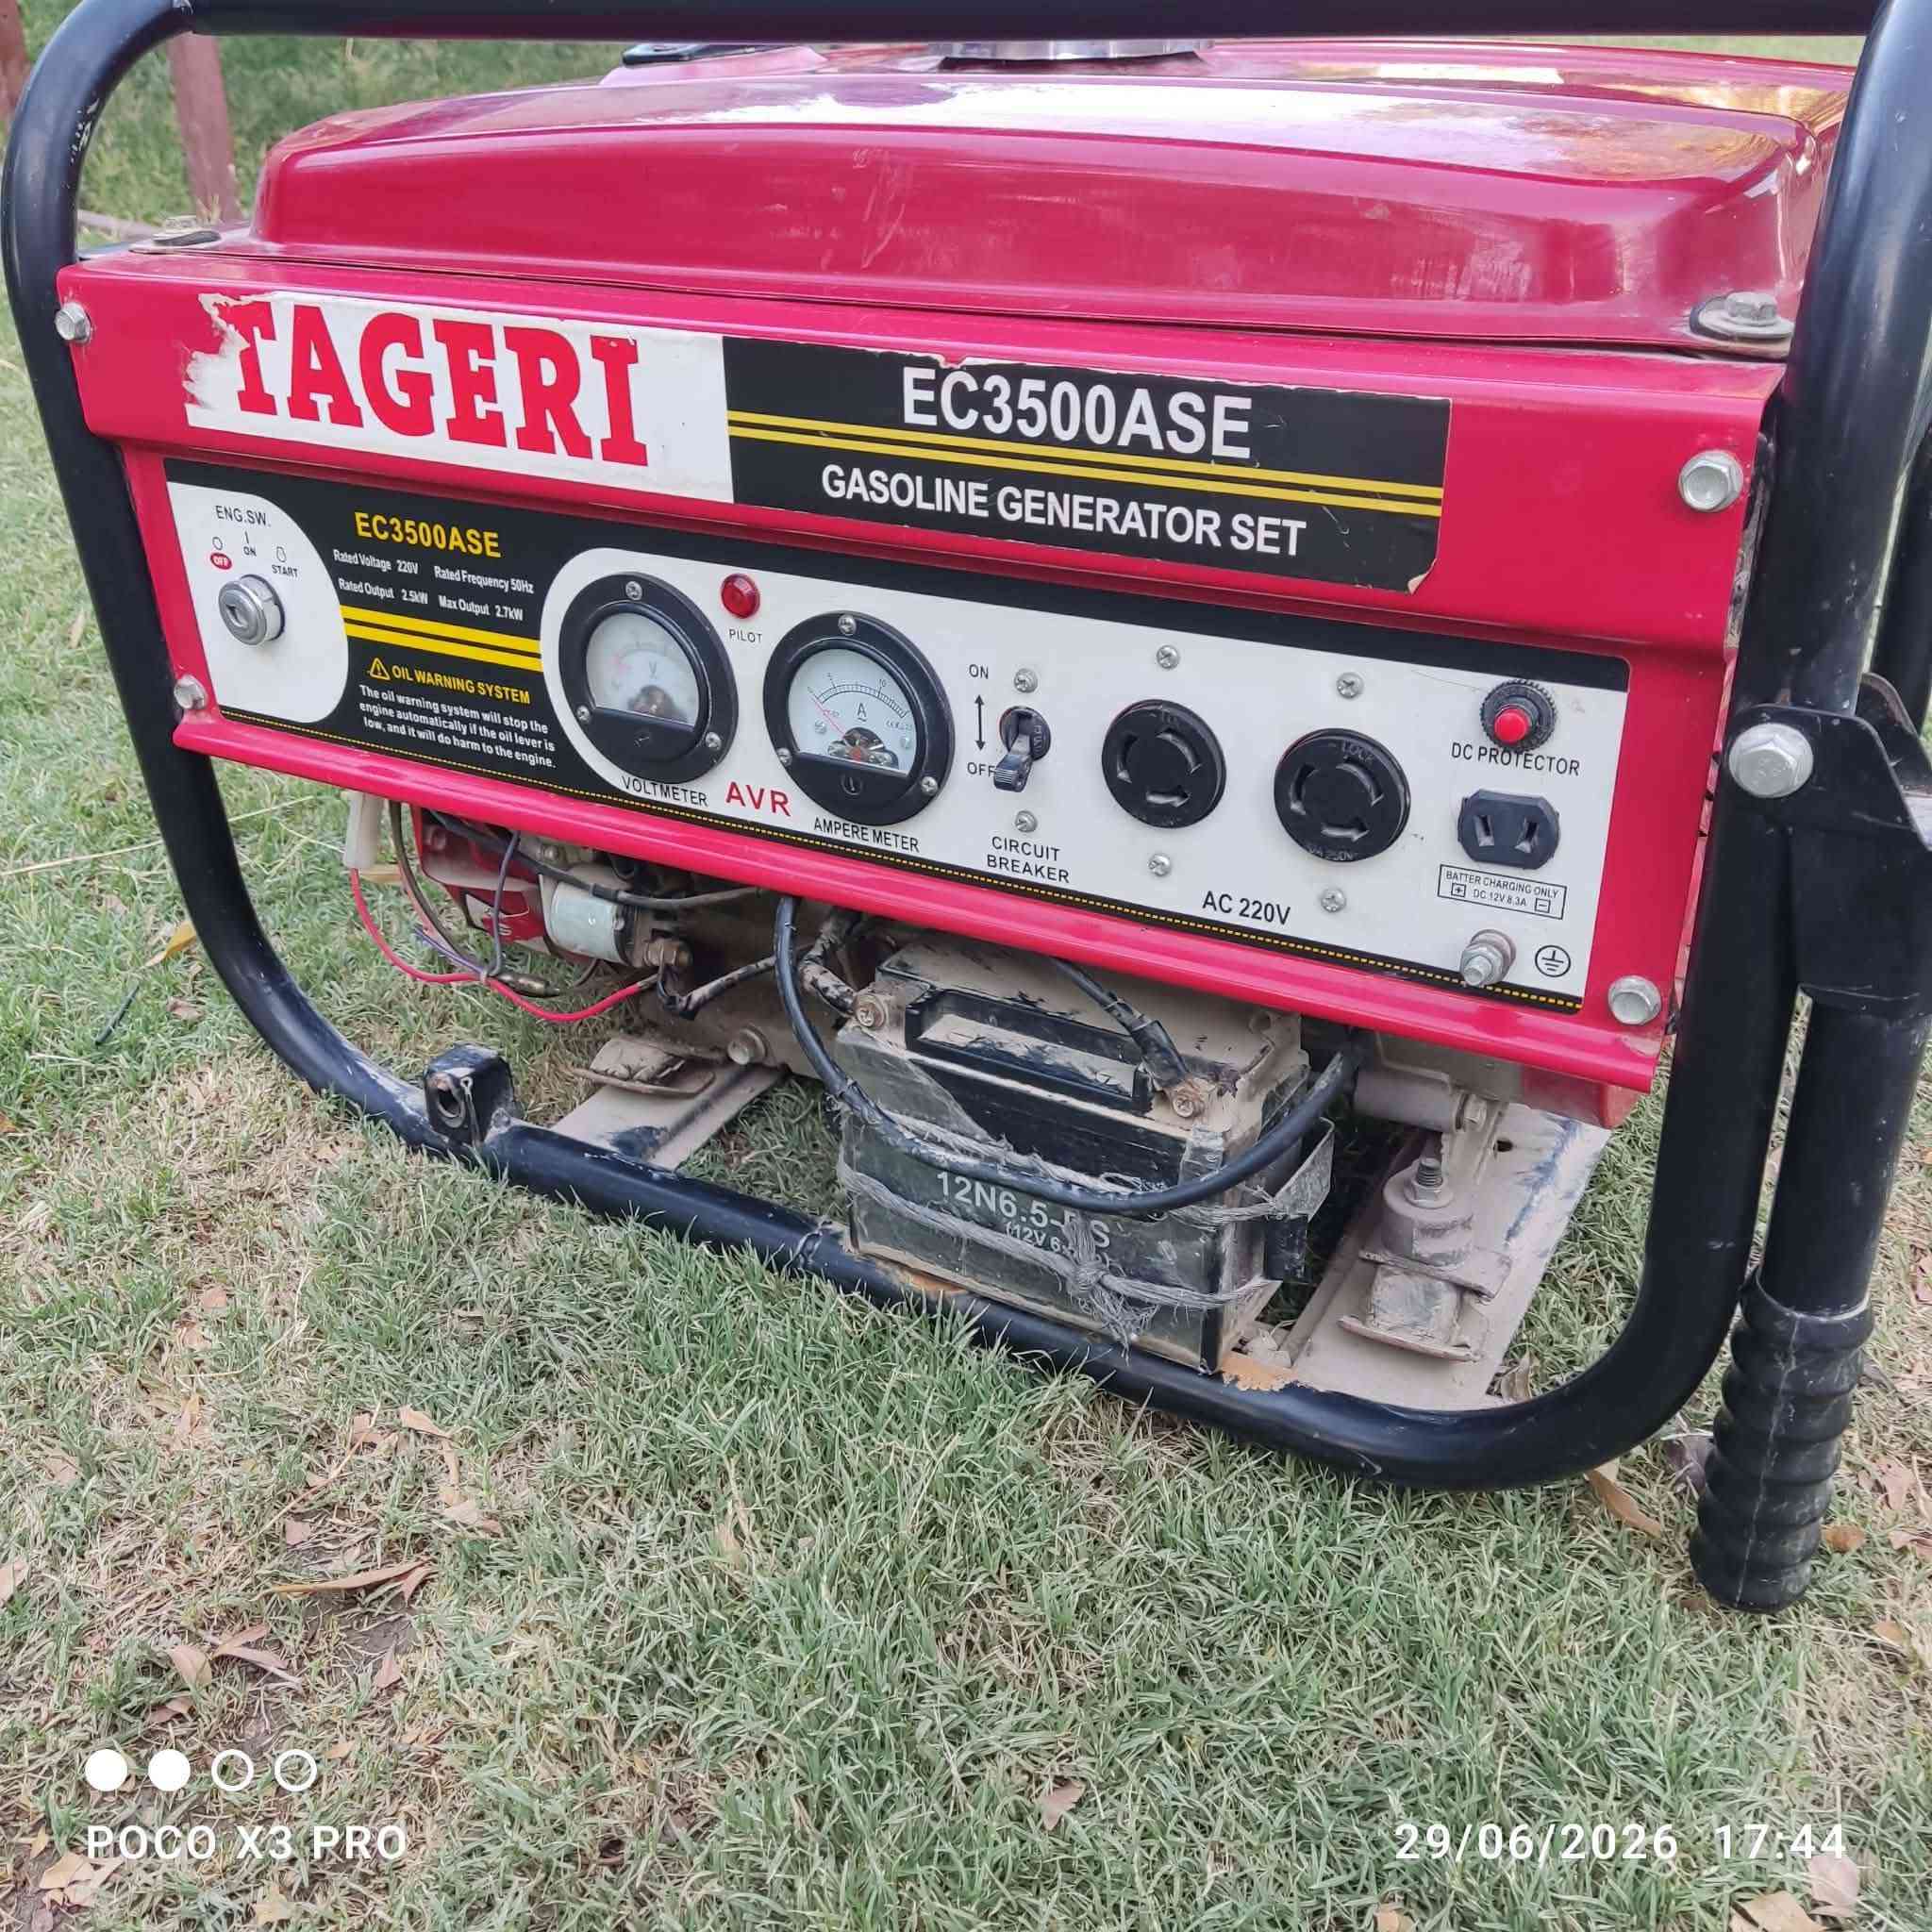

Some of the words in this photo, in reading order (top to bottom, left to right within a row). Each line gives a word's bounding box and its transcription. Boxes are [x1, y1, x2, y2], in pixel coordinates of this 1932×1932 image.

[217, 301, 648, 467] TAGERI
[901, 366, 1253, 460] EC3500ASE
[821, 463, 989, 520] GASOLINE
[995, 485, 1223, 549] GENERATOR
[1229, 514, 1307, 557] SET
[354, 510, 502, 558] EC3500ASE
[242, 545, 258, 558] ON
[333, 549, 358, 565] Rated
[359, 553, 392, 573] Voltage
[396, 559, 419, 575] 220V
[271, 564, 298, 577] START
[434, 565, 461, 582] Rated
[462, 570, 509, 592] Frequency
[510, 578, 535, 594] 50Hz
[338, 577, 363, 593] Rated
[364, 582, 395, 600] Output
[401, 589, 429, 605] 2.5kW
[438, 594, 458, 609] Max
[458, 598, 491, 616] Output
[495, 605, 524, 621] 2.7kW
[728, 628, 763, 643] PILOT
[391, 664, 413, 681] OIL
[414, 670, 475, 693] WARNING
[476, 682, 531, 705] SYSTEM
[968, 663, 990, 680] ON
[359, 684, 380, 699] The
[381, 691, 396, 703] oil
[396, 694, 440, 713] warning
[441, 703, 480, 720] system
[481, 710, 502, 724] will
[502, 714, 528, 731] stop
[529, 720, 548, 735] the
[857, 702, 867, 718] A
[359, 702, 395, 719] engine
[396, 709, 468, 735] automatically
[469, 723, 478, 735] if
[479, 725, 497, 740] the
[498, 730, 513, 743] oil
[514, 732, 542, 748] lever
[543, 738, 556, 752] is
[387, 720, 407, 736] and
[408, 724, 416, 738] it
[417, 727, 437, 741] will
[438, 731, 453, 745] do
[453, 736, 481, 752] harm
[482, 741, 494, 755] to
[494, 743, 513, 758] the
[514, 750, 557, 769] engine.
[1451, 741, 1473, 760] DC
[1477, 745, 1581, 777] PROTECTOR
[966, 761, 996, 777] OFF
[621, 774, 708, 808] VOLTMETER
[724, 780, 791, 817] AVR
[813, 816, 869, 842] AMPERE
[872, 828, 921, 853] METER
[991, 835, 1061, 862] CIRCUIT
[986, 854, 1071, 884] BREAKER
[1445, 870, 1482, 886] BATTER
[1483, 876, 1533, 894] CHARGING
[1534, 885, 1559, 899] ONLY
[1473, 888, 1487, 899] DC
[1202, 890, 1233, 914] AC
[1239, 897, 1291, 925] 220V
